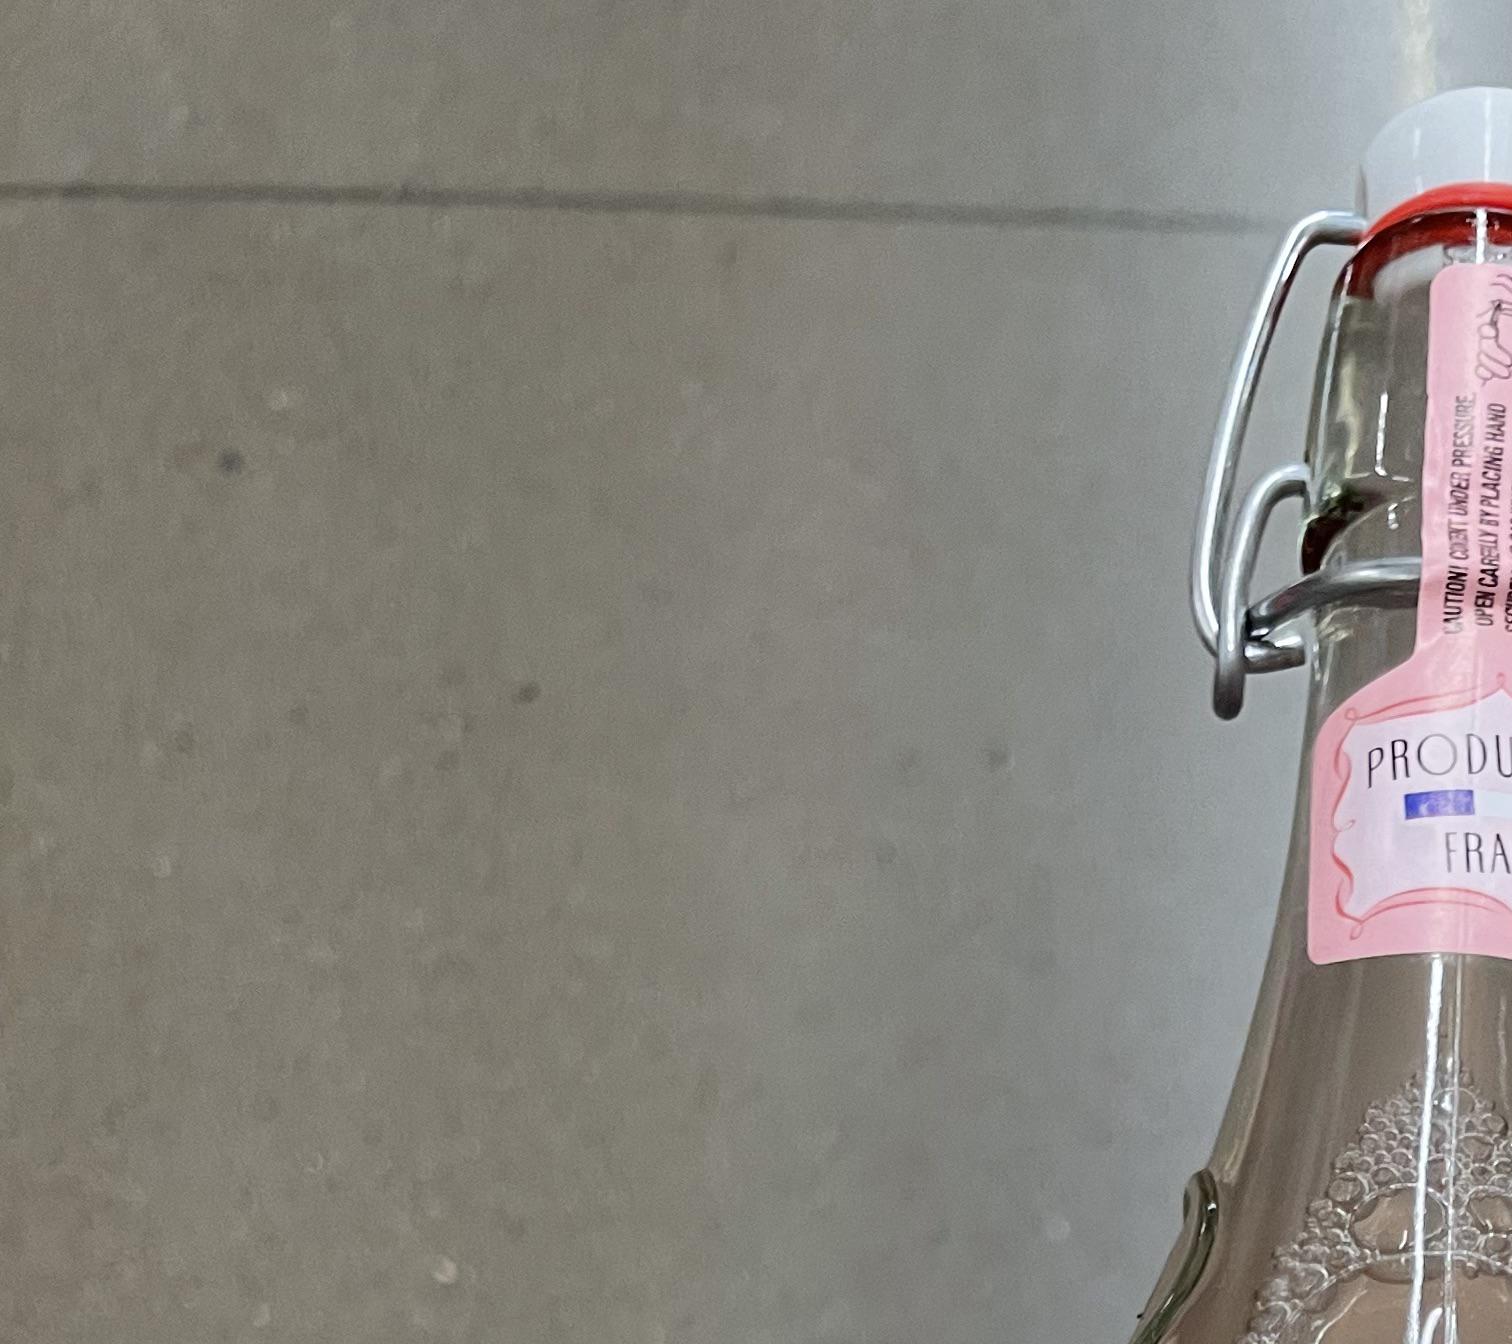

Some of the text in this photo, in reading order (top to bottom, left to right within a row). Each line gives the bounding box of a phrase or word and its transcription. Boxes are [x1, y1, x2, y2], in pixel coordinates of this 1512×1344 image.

[1486, 403, 1506, 442] HAND
[1448, 472, 1471, 516] UNDER
[1480, 446, 1504, 508] PLACING
[1480, 508, 1499, 527] BY
[1474, 591, 1495, 626] OPEN
